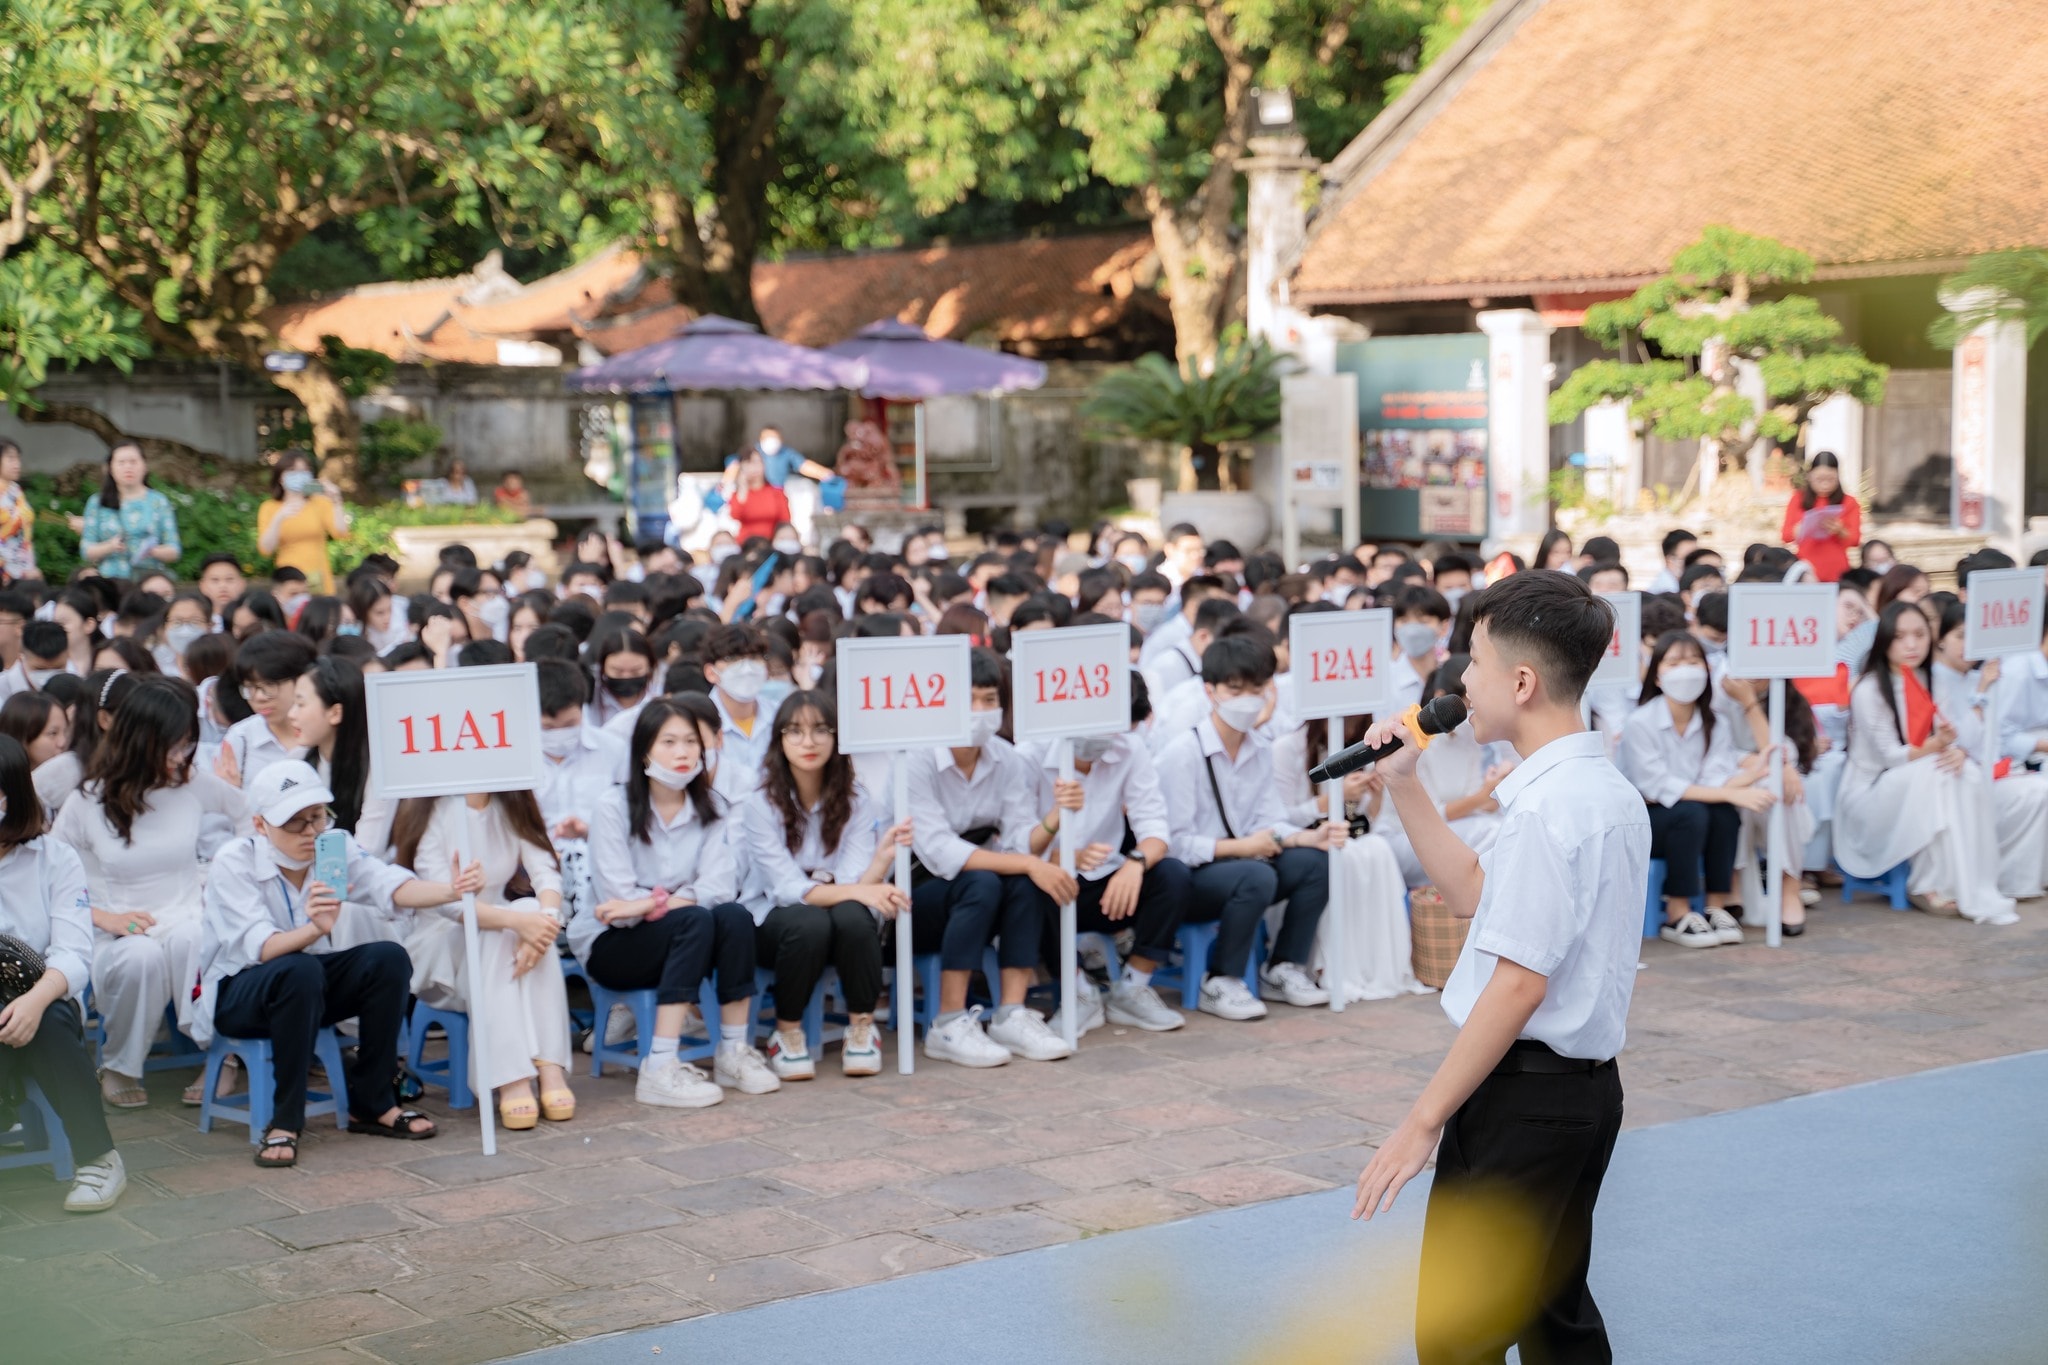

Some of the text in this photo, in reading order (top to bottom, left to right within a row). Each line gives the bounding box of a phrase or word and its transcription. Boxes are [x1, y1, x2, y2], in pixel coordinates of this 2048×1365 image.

[1750, 617, 1818, 646] 11A3
[1981, 599, 2030, 629] 10A6
[1035, 663, 1111, 704] 12A3
[1311, 647, 1374, 683] 12A4
[860, 672, 946, 711] 11A2
[399, 709, 512, 755] 11A1
